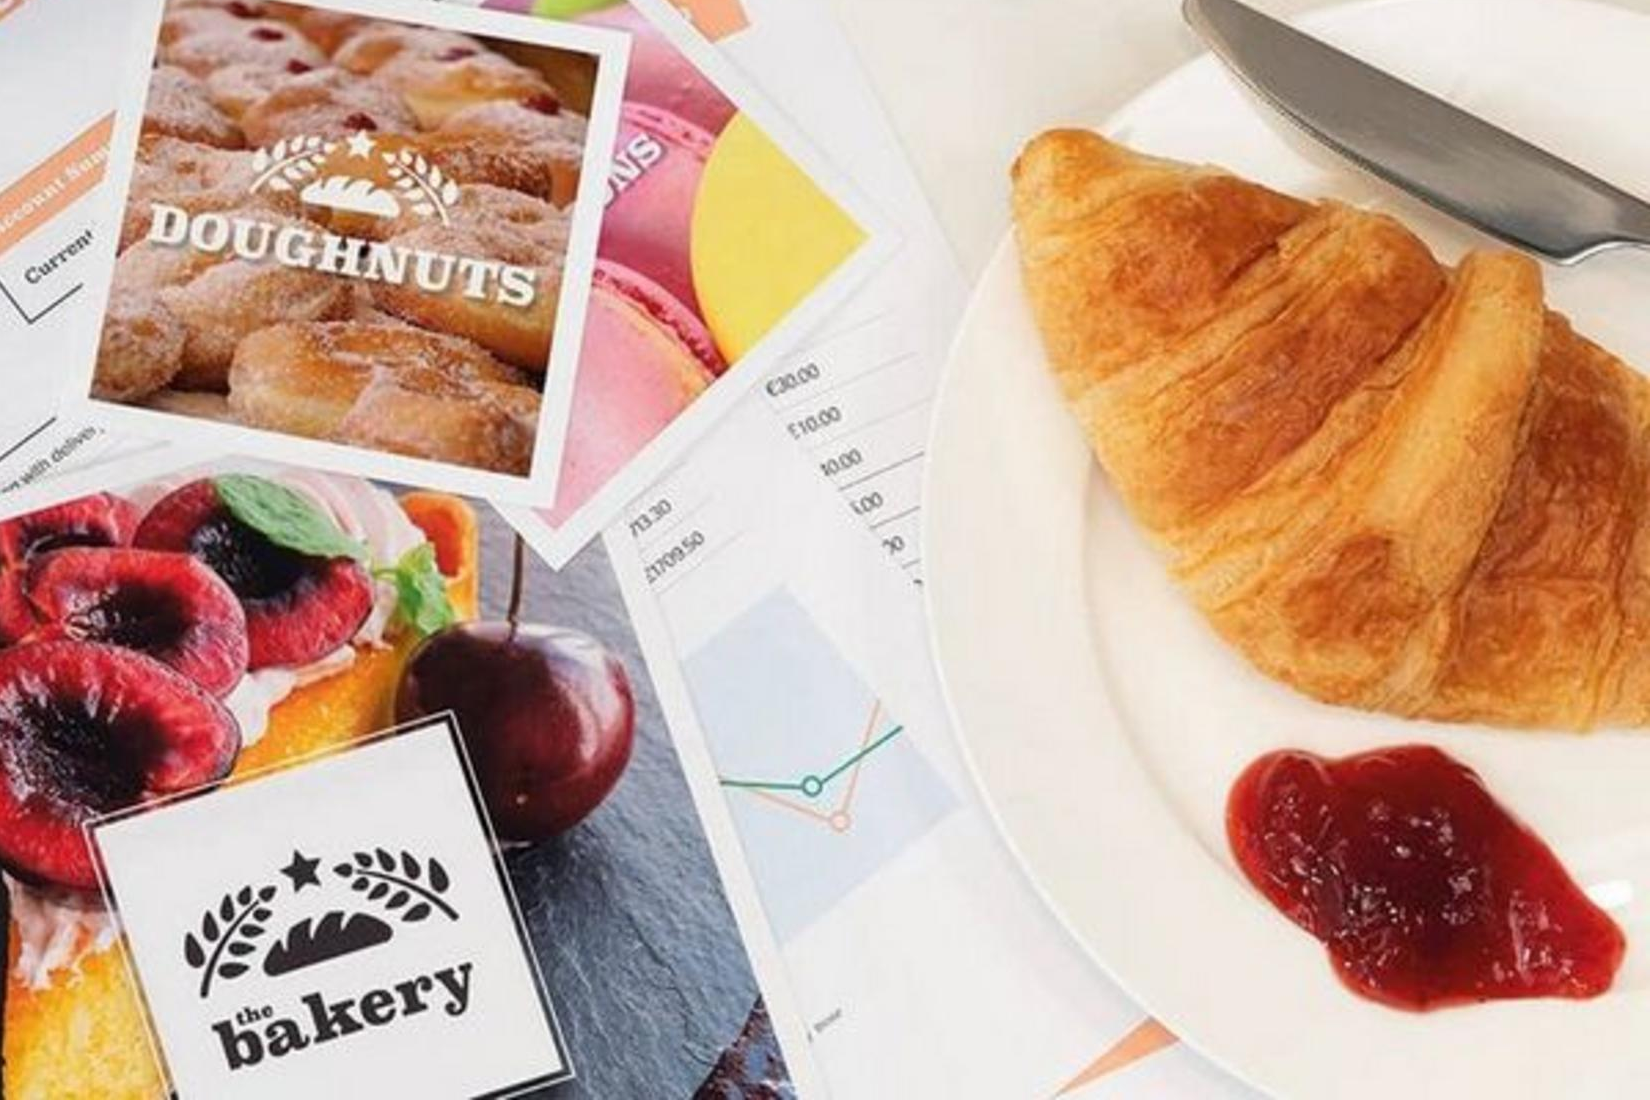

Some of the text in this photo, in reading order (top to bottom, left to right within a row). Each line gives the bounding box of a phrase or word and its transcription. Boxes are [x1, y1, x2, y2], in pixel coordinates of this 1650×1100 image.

[149, 203, 538, 308] DOUGHNUTS
[211, 962, 473, 1071] bakery
[236, 1005, 274, 1027] the
